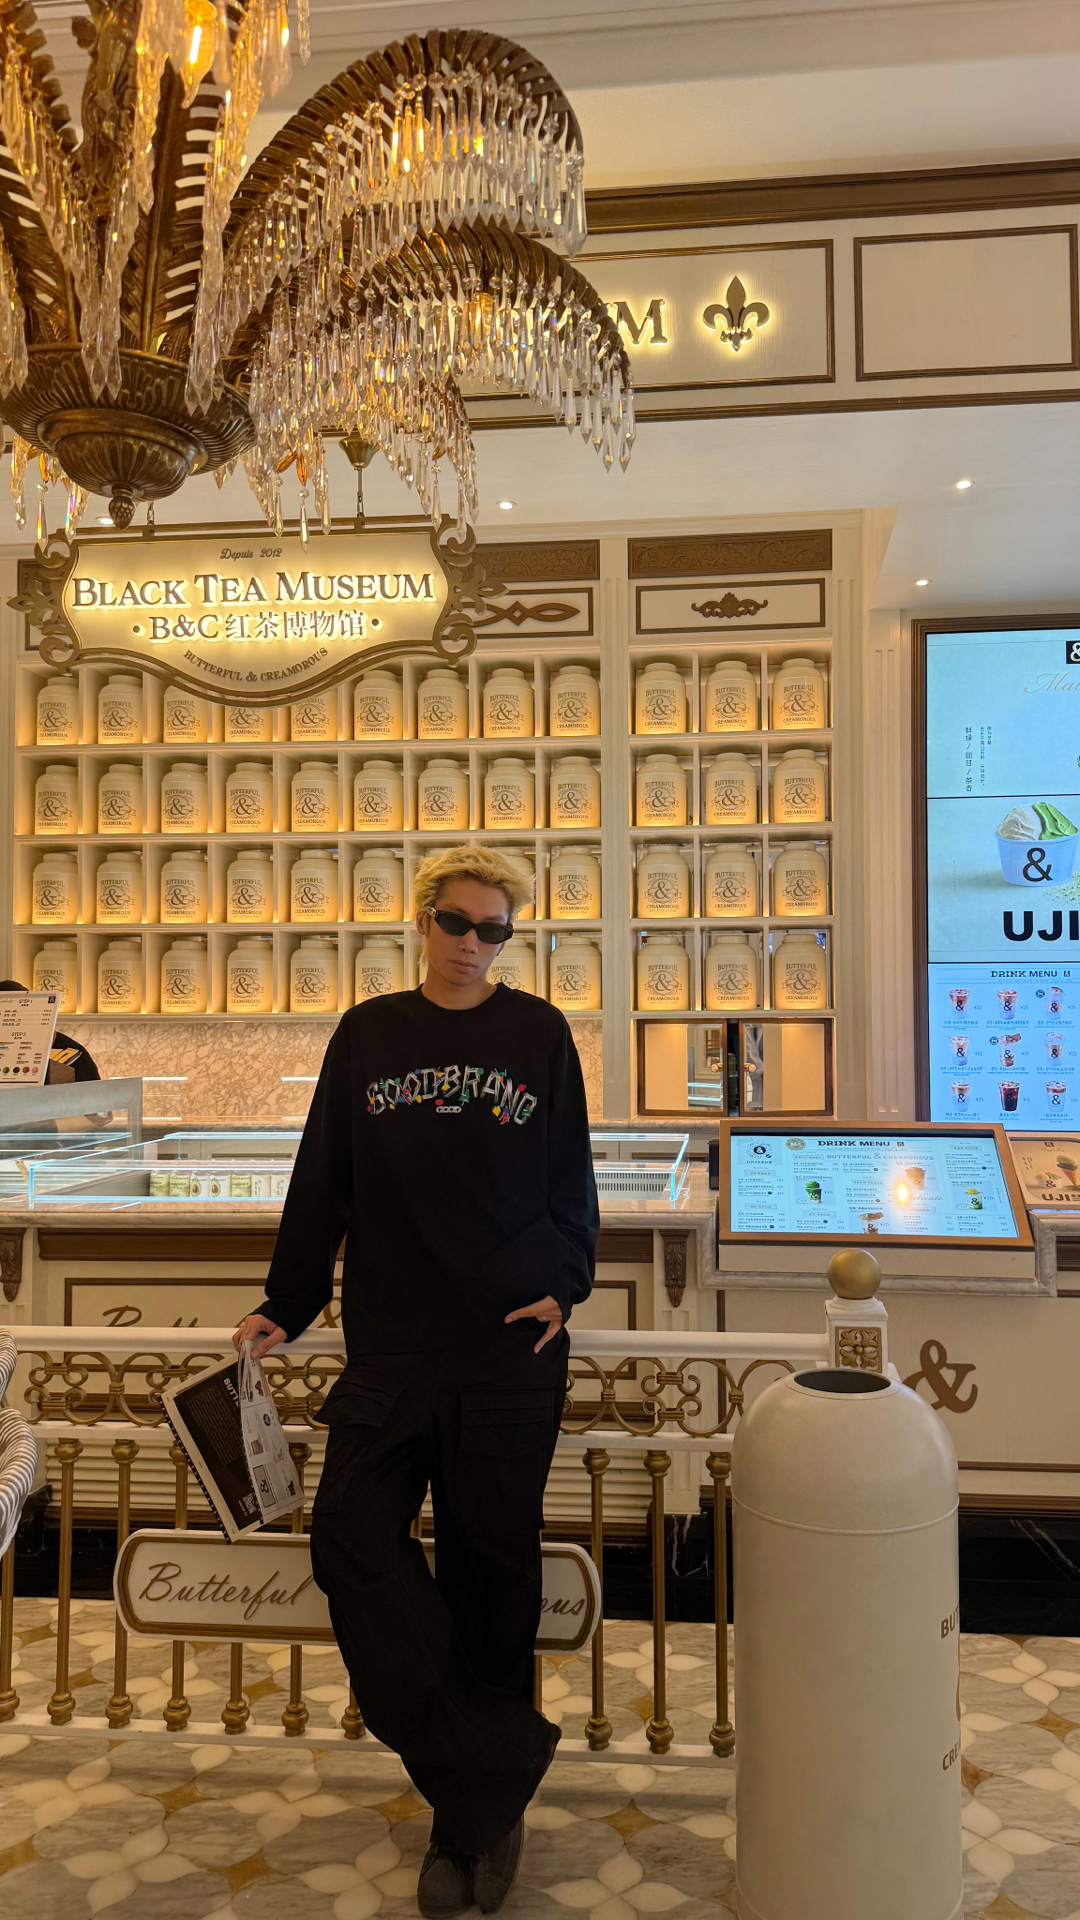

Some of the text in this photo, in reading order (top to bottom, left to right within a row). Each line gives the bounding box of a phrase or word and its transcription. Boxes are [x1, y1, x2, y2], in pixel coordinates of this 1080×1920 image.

[220, 548, 282, 561] Depuis 2012
[72, 571, 435, 608] BLACK TEA MUSEUM
[183, 647, 328, 682] BUTTERFUL & CREAMOROUS
[496, 703, 512, 720] &
[564, 701, 580, 718] &
[653, 698, 670, 716] &
[723, 696, 739, 714] &
[791, 694, 808, 712] &
[44, 712, 60, 727] &
[109, 712, 125, 727] &
[173, 711, 189, 726] &
[236, 708, 252, 725] &
[302, 707, 318, 724] &
[366, 705, 382, 722] &
[429, 705, 446, 721] &
[365, 796, 380, 813] &
[430, 795, 446, 812] &
[497, 794, 514, 811] &
[564, 792, 580, 809] &
[652, 790, 669, 808] &
[722, 789, 738, 806] &
[792, 787, 809, 805] &
[44, 802, 59, 817] &
[108, 801, 124, 816] &
[170, 800, 186, 816] &
[236, 800, 252, 815] &
[302, 799, 318, 814] &
[1023, 848, 1053, 882] &
[301, 887, 317, 904] &
[366, 886, 382, 903] &
[565, 883, 581, 900] &
[655, 882, 672, 899] &
[723, 881, 739, 898] &
[793, 879, 810, 897] &
[40, 889, 57, 906] &
[106, 889, 122, 906] &
[171, 888, 187, 906] &
[238, 888, 254, 906] &
[1003, 911, 1079, 941] UJI
[106, 978, 122, 996] &
[171, 978, 187, 996] &
[236, 978, 252, 995] &
[302, 978, 318, 995] &
[368, 977, 384, 994] &
[563, 974, 579, 991] &
[655, 974, 672, 991] &
[726, 973, 743, 991] &
[793, 973, 810, 990] &
[903, 1339, 978, 1413] &
[139, 1562, 313, 1620] Butterful
